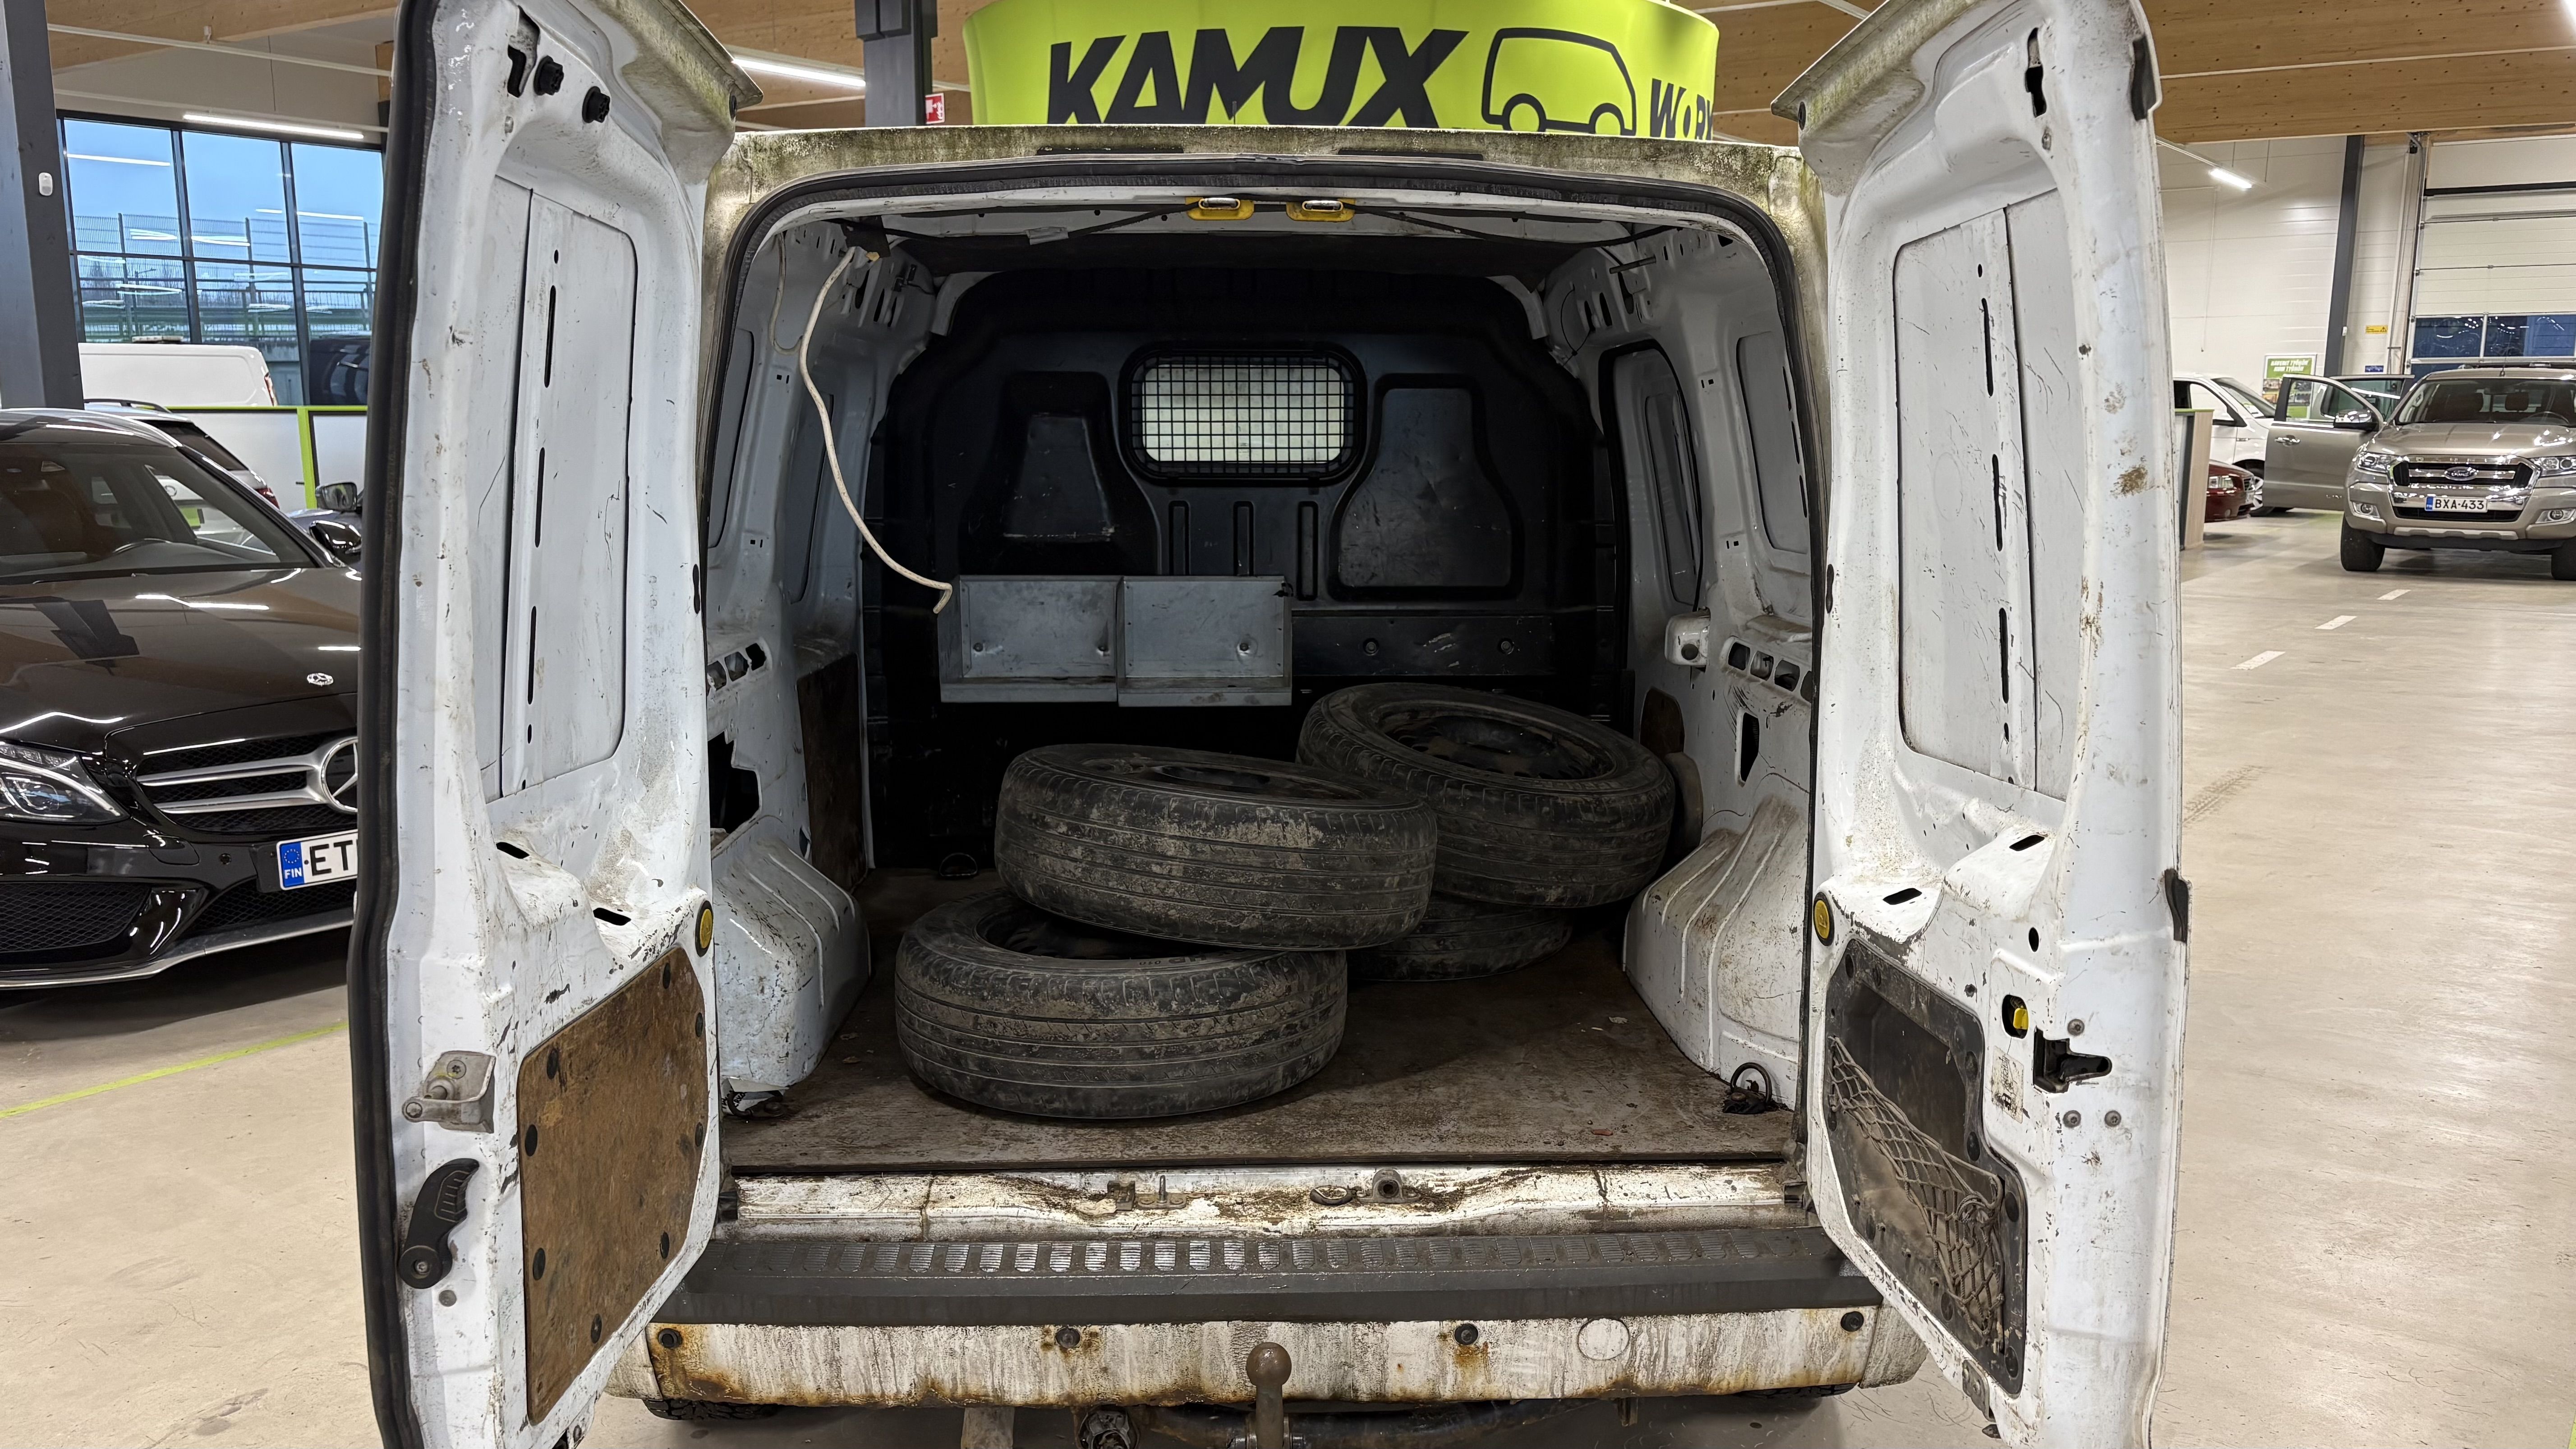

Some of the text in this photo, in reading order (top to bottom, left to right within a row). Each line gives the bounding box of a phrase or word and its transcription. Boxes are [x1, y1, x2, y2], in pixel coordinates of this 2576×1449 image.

[1047, 26, 1470, 128] KAMUX
[284, 867, 302, 879] FIN
[309, 839, 358, 876] ET
